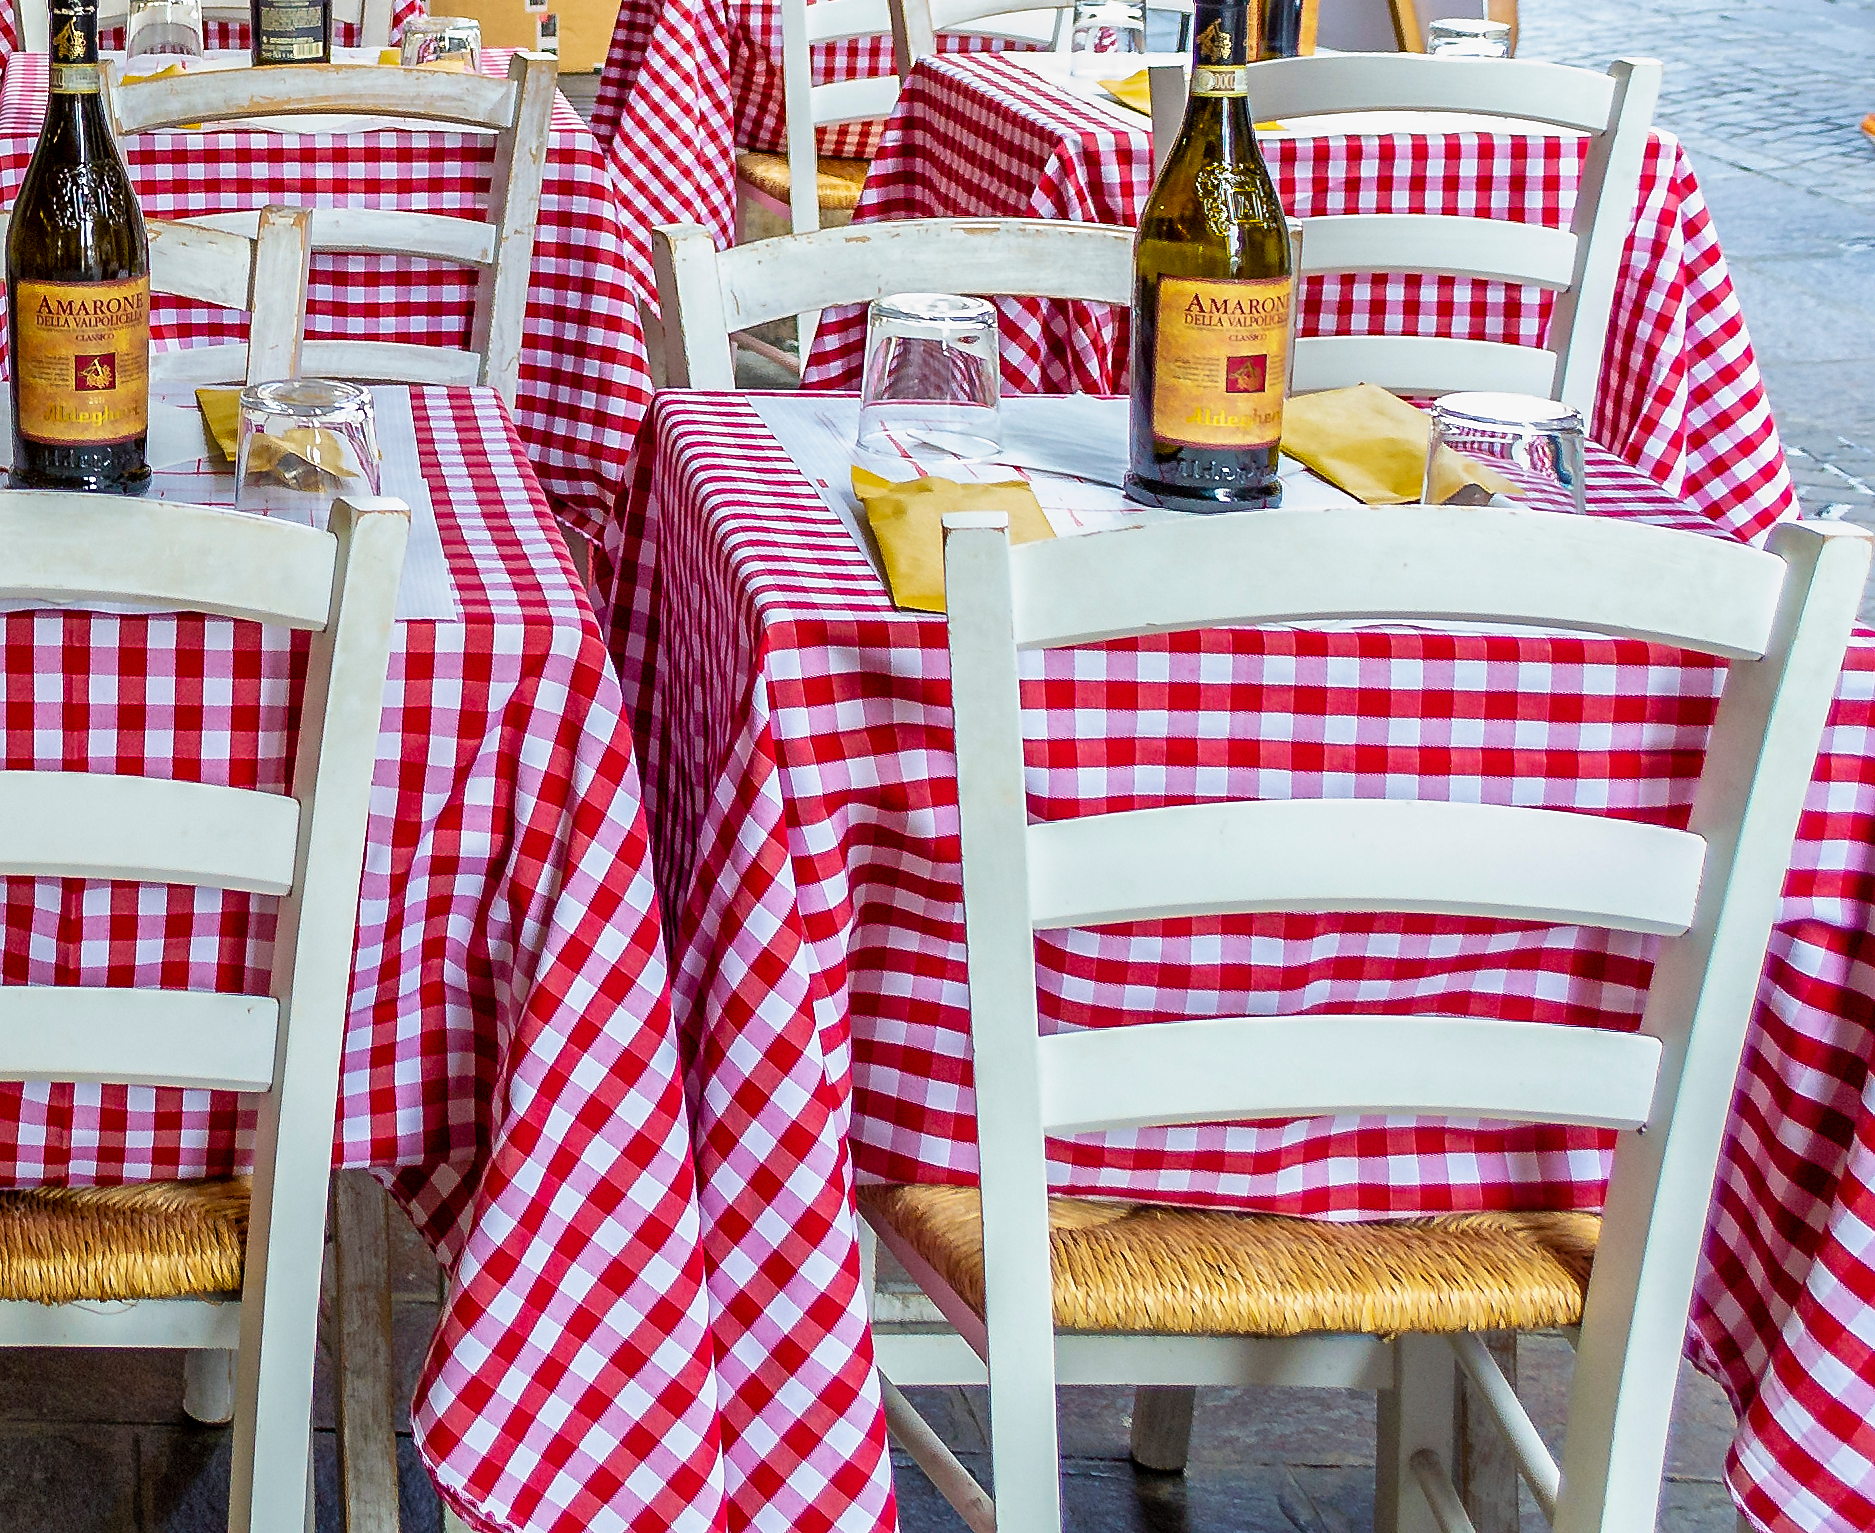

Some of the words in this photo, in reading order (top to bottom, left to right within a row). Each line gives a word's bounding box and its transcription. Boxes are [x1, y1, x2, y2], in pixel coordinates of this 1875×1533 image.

[36, 292, 143, 316] AMARONE
[36, 314, 71, 328] DELLA
[72, 310, 143, 328] VALPOLICELLA
[1184, 313, 1224, 327] DELLA
